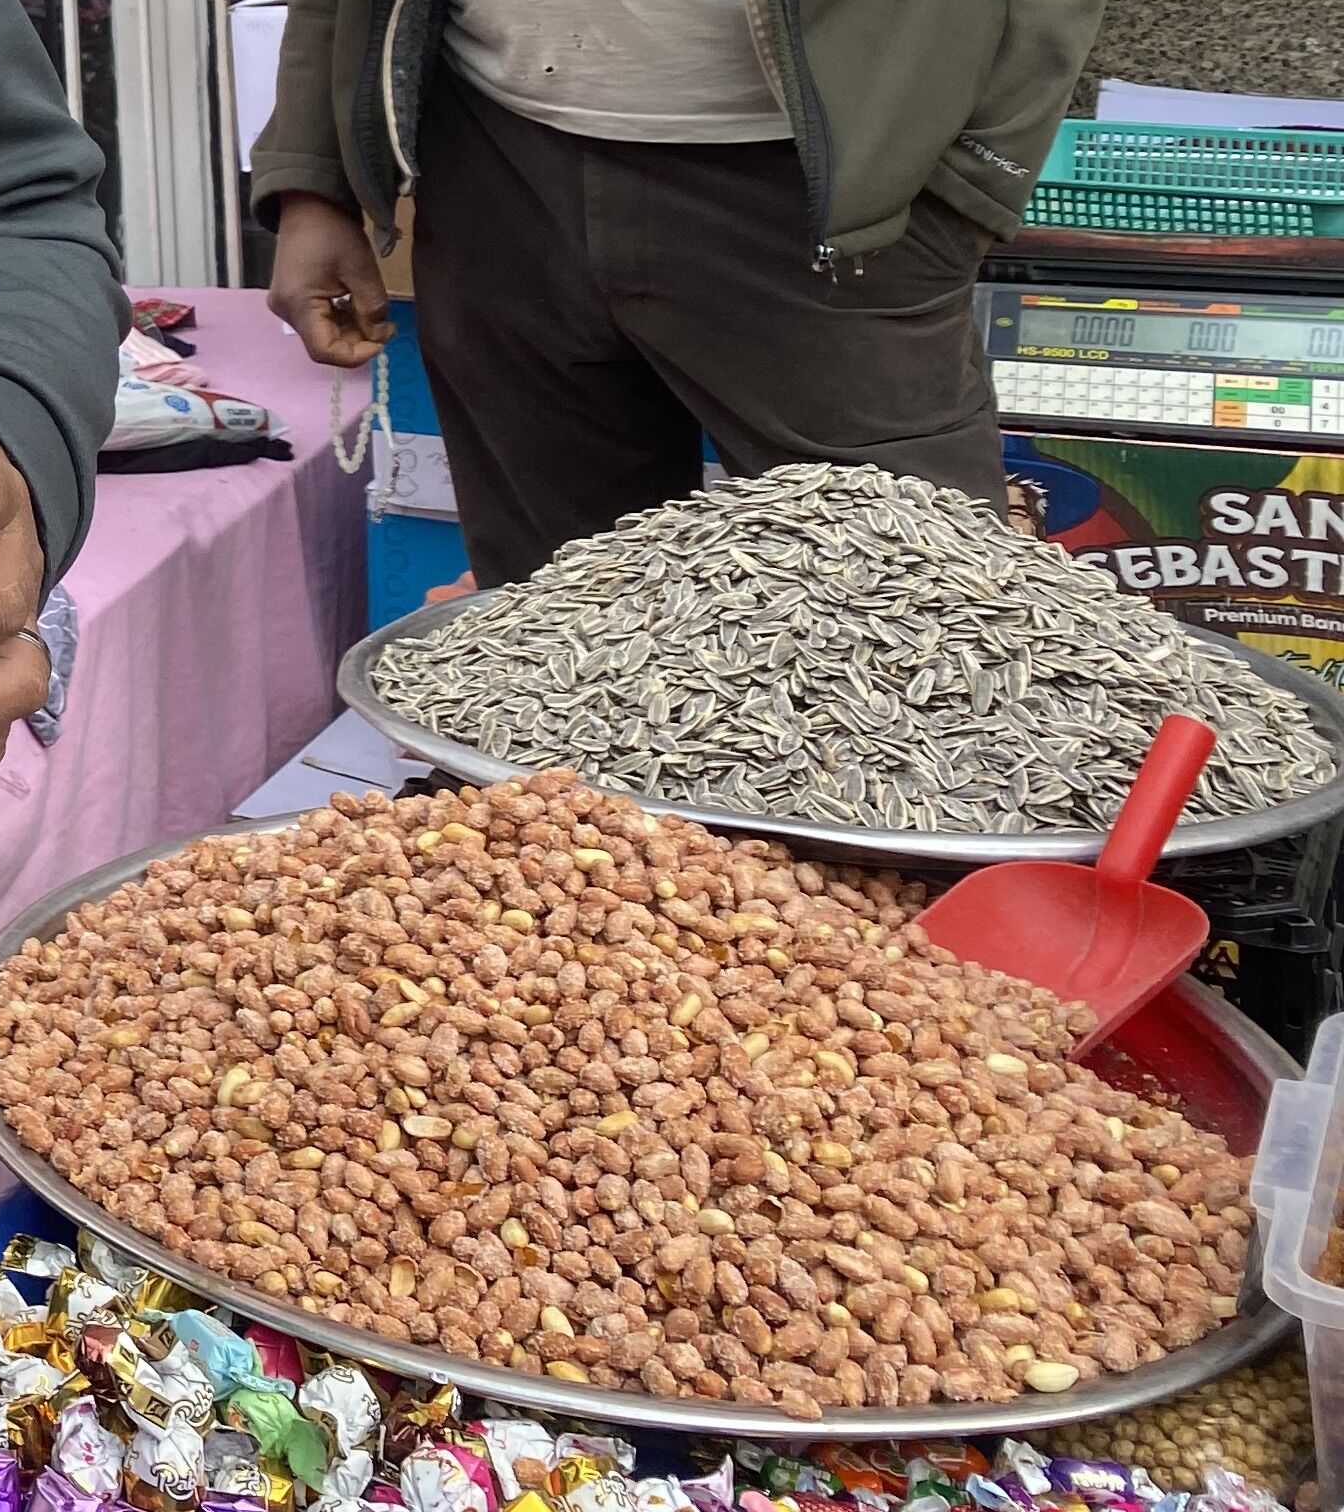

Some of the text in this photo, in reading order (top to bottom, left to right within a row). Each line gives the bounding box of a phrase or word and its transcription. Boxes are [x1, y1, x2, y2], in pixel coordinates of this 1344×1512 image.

[1072, 315, 1135, 346] 0.000
[1188, 321, 1237, 352] 0.00
[1017, 345, 1109, 360] HS-9500 LCD
[1209, 492, 1344, 541] SAN
[1075, 544, 1344, 595] SEBAST
[1204, 608, 1344, 633] Premium Ban
